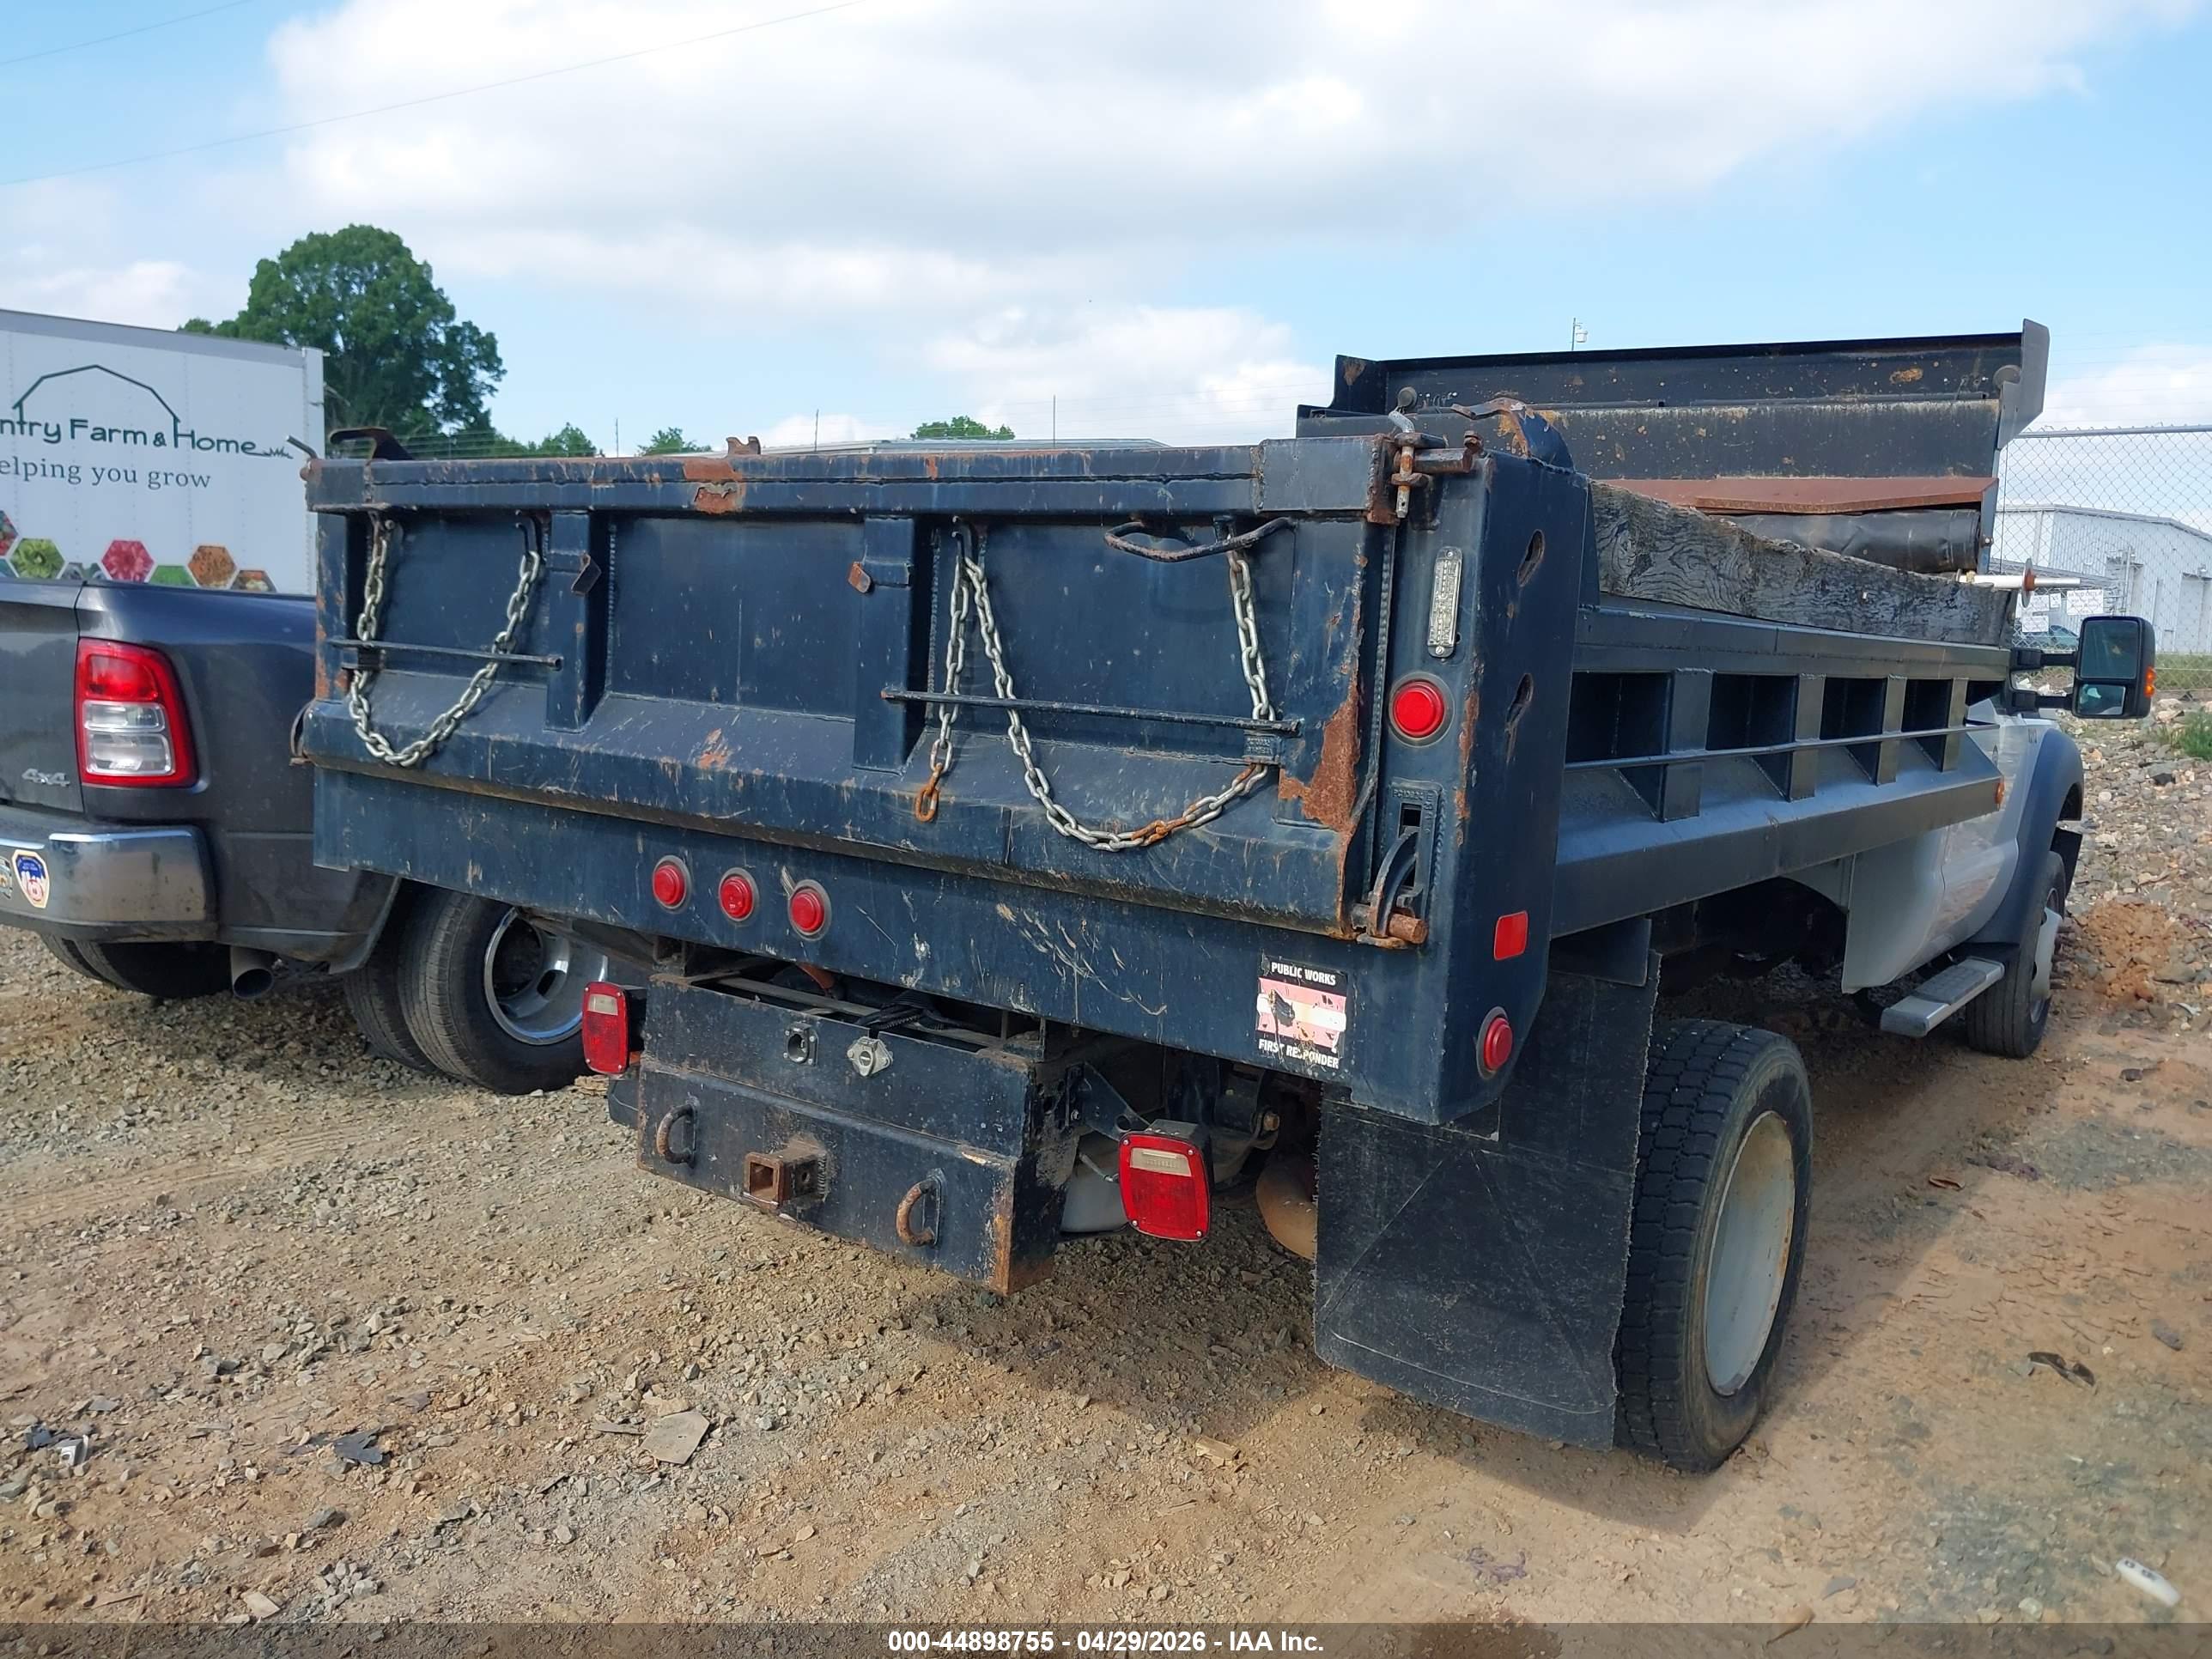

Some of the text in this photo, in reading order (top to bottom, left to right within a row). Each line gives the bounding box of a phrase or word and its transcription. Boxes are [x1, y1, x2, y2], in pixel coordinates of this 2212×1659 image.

[70, 418, 148, 446] Farm
[153, 431, 167, 447] &
[173, 422, 261, 456] Home
[91, 465, 138, 487] you
[148, 471, 211, 490] grow
[21, 768, 71, 787] 4x4
[1271, 962, 1336, 986] PUBLIC WORKS
[1258, 1038, 1285, 1054] FIRST
